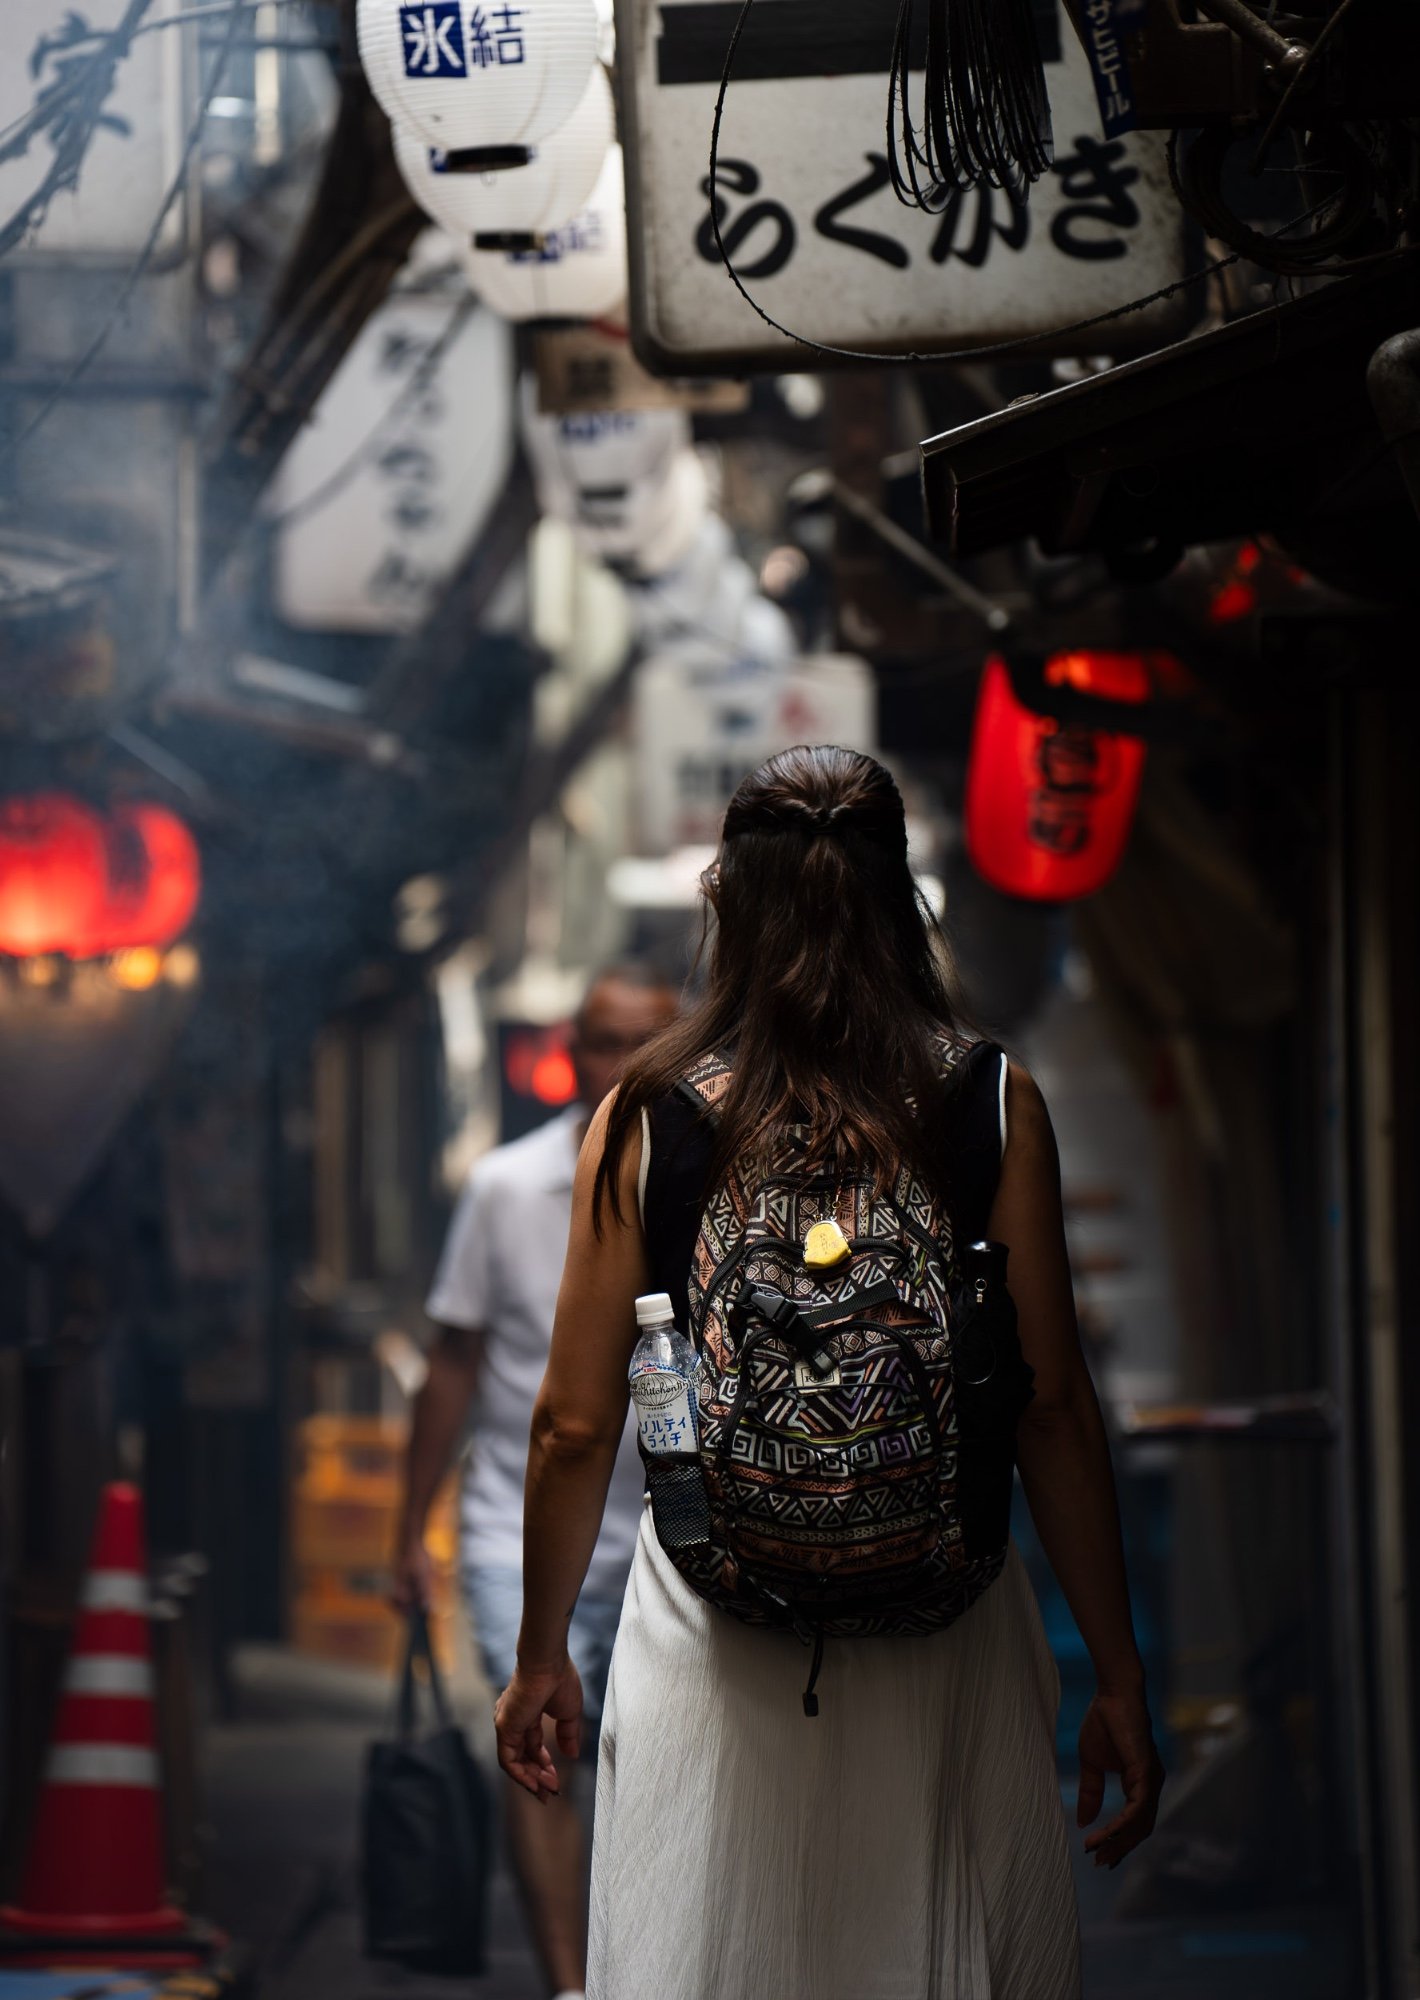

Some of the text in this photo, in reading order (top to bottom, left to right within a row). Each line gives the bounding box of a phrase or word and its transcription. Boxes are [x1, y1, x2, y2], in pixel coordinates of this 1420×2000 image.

[400, 2, 528, 76] 氷結
[639, 1416, 686, 1435] ソルティ
[647, 1431, 682, 1448] ライチ
